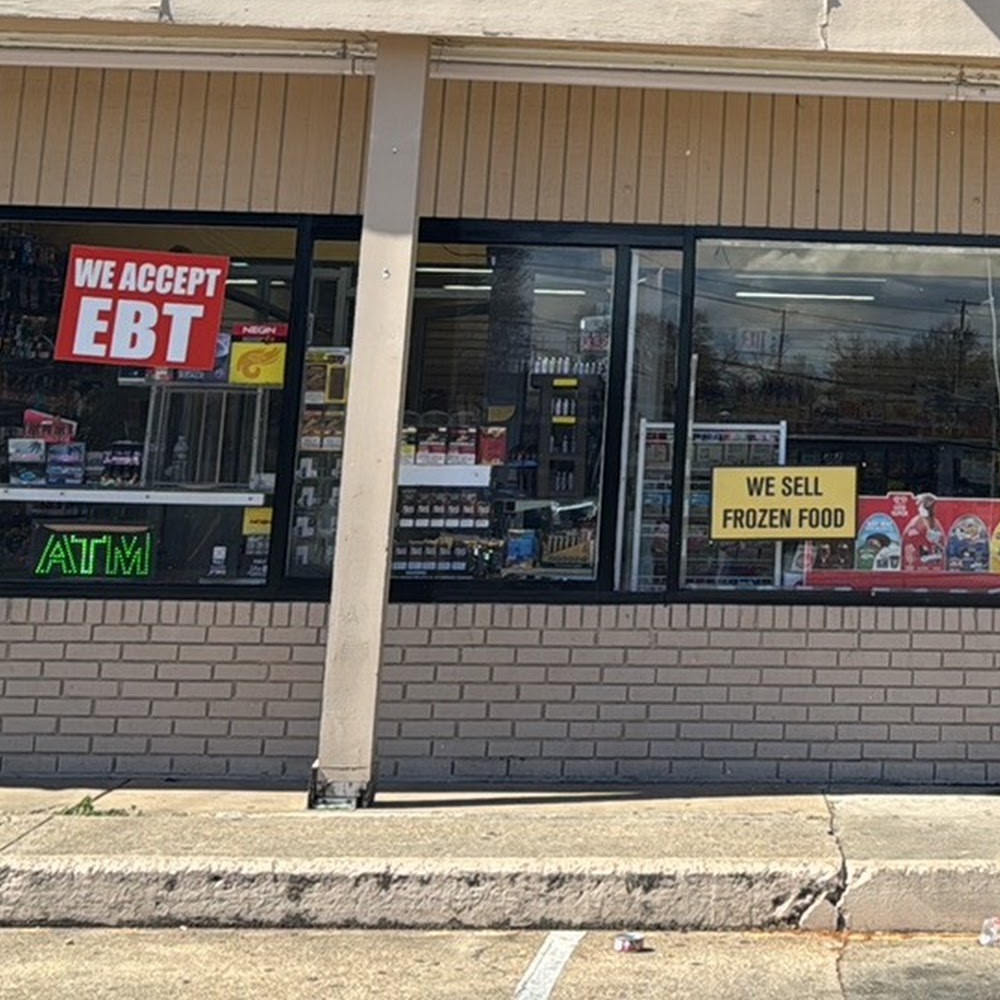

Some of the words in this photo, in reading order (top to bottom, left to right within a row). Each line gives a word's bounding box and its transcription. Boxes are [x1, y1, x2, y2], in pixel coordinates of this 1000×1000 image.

[74, 258, 113, 289] WE
[118, 262, 221, 297] ACCEPT
[72, 296, 204, 363] EBT
[746, 476, 775, 496] WE
[781, 477, 823, 497] SELL
[722, 508, 792, 529] FROZEN
[799, 508, 845, 529] FOOD
[34, 532, 151, 575] ATM
